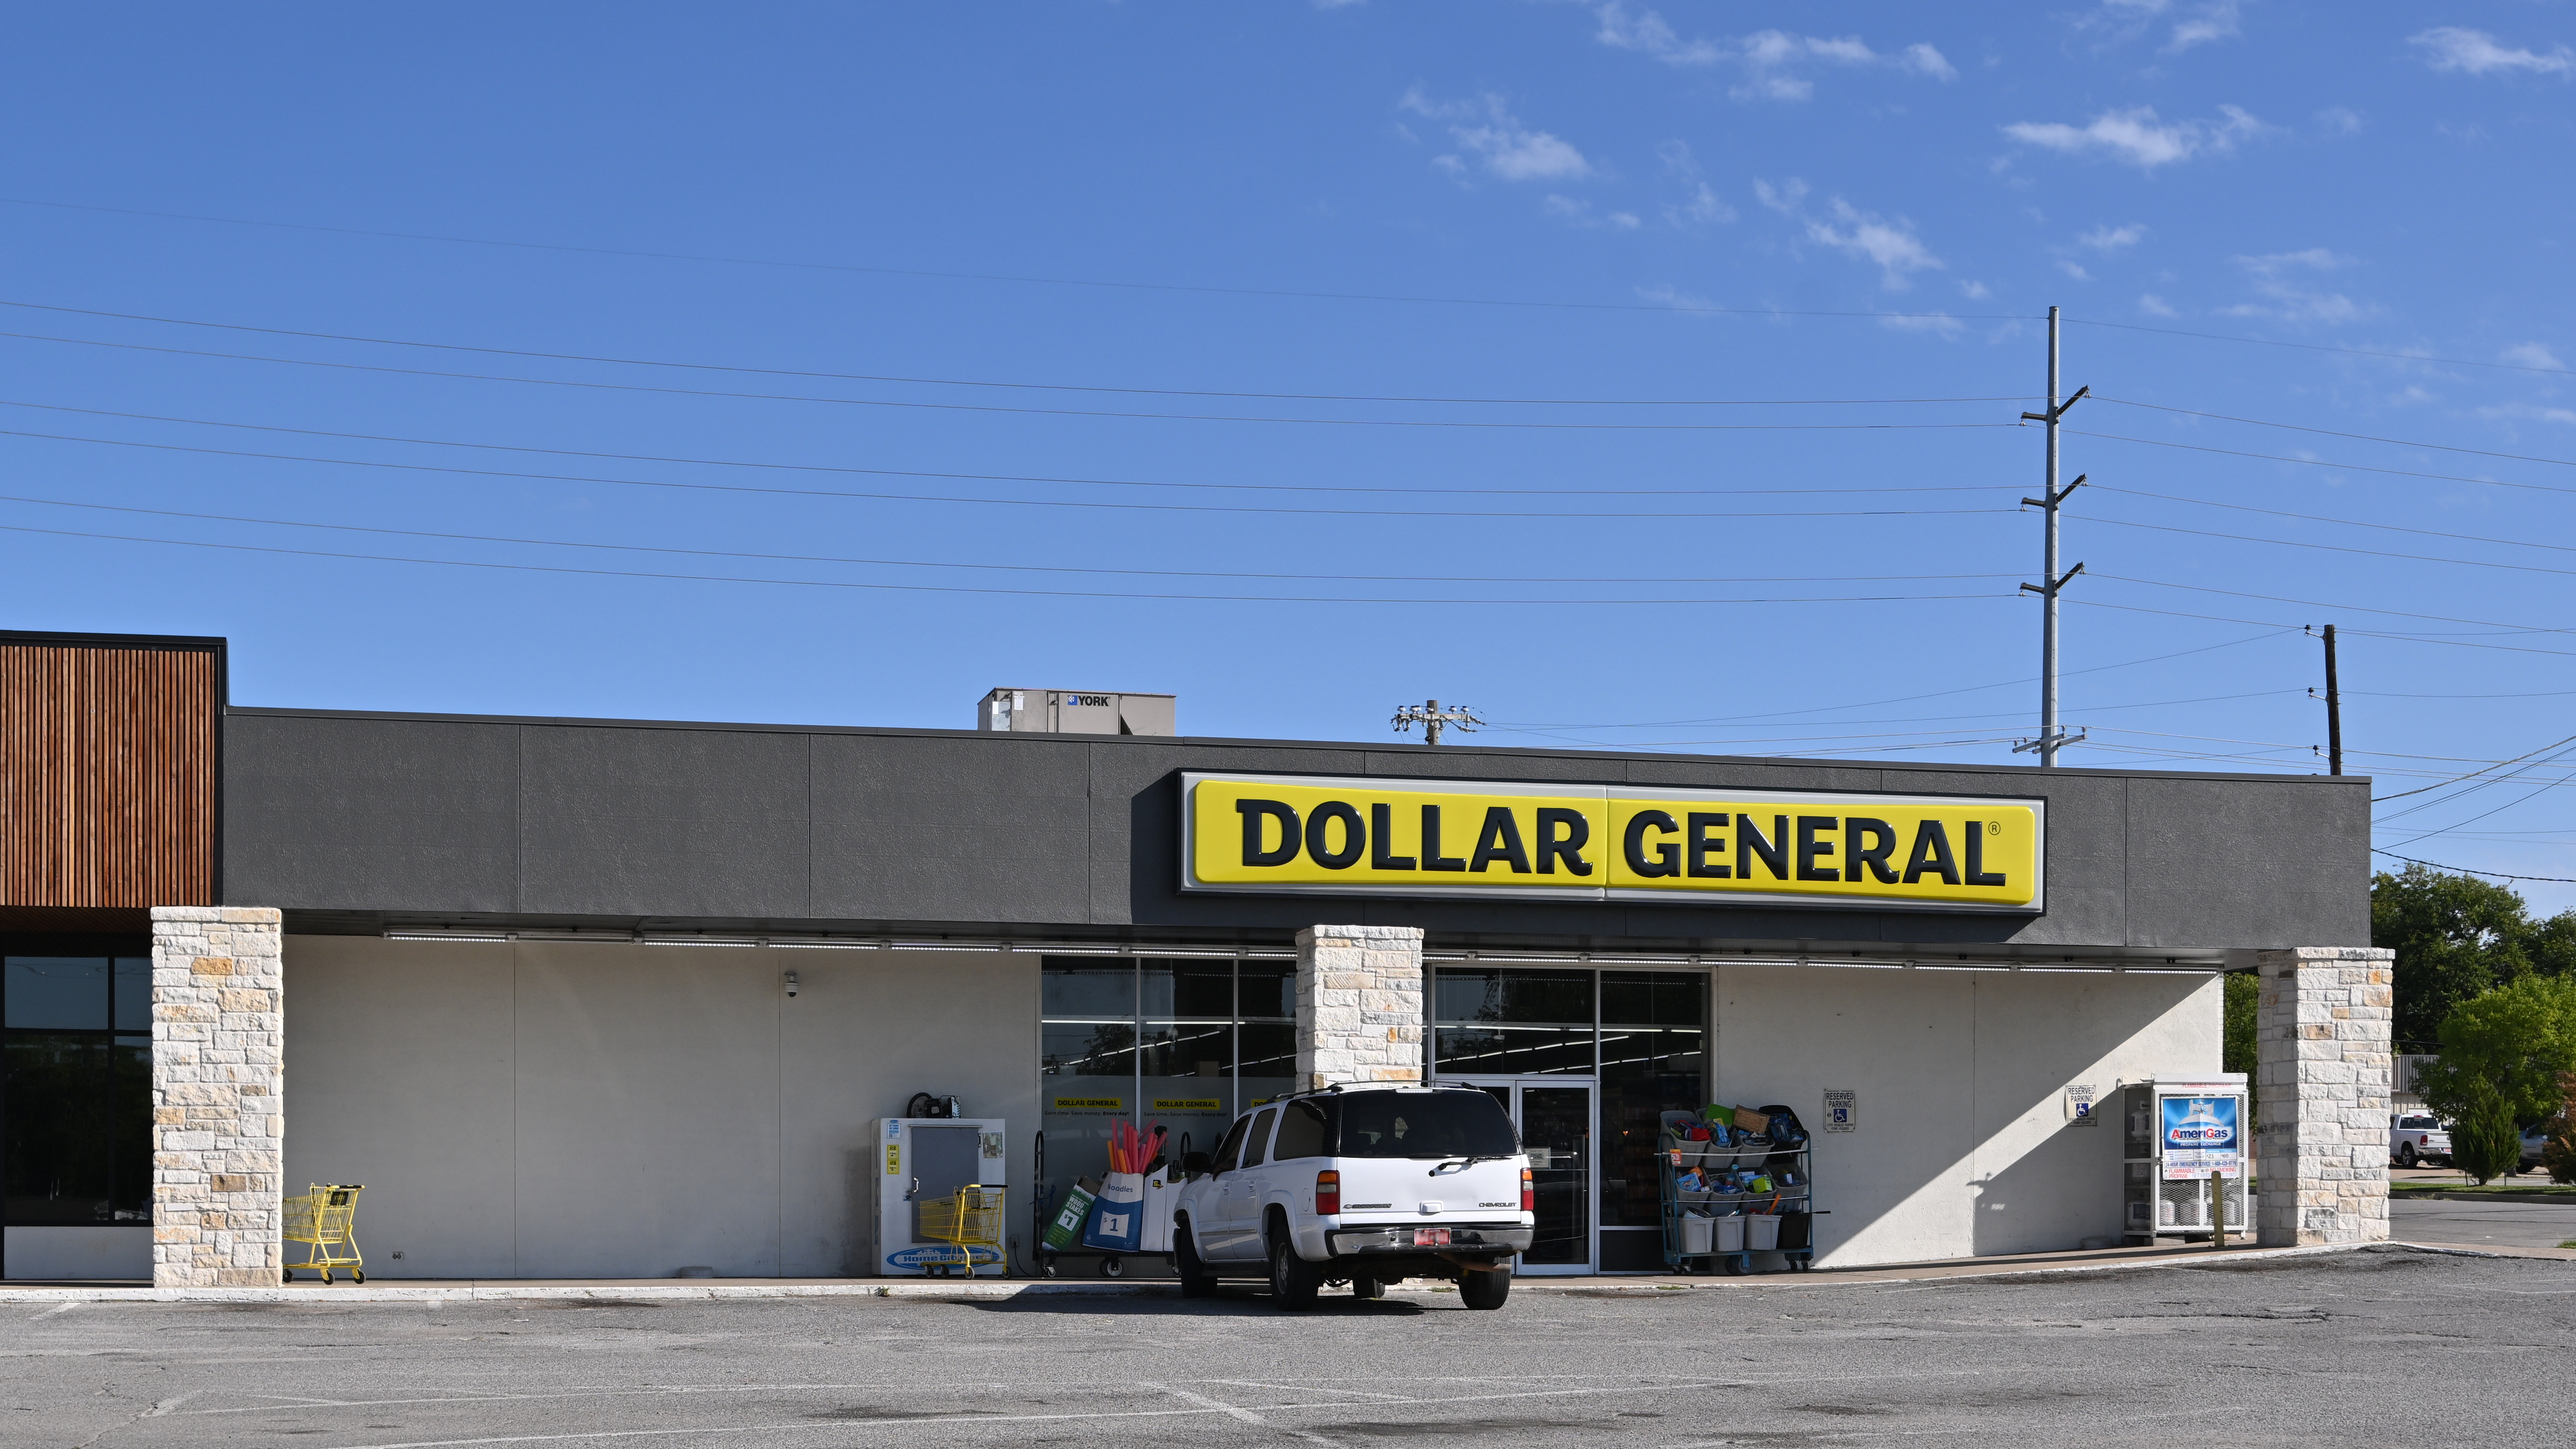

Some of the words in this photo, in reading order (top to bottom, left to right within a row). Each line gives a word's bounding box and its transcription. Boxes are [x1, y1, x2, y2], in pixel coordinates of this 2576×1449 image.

[1236, 798, 1594, 877] DOLLAR
[2171, 1129, 2228, 1139] AmeriGas
[1107, 1184, 1133, 1193] Noodles
[1065, 1202, 1084, 1216] STAKES
[1069, 1196, 1085, 1209] WOOD
